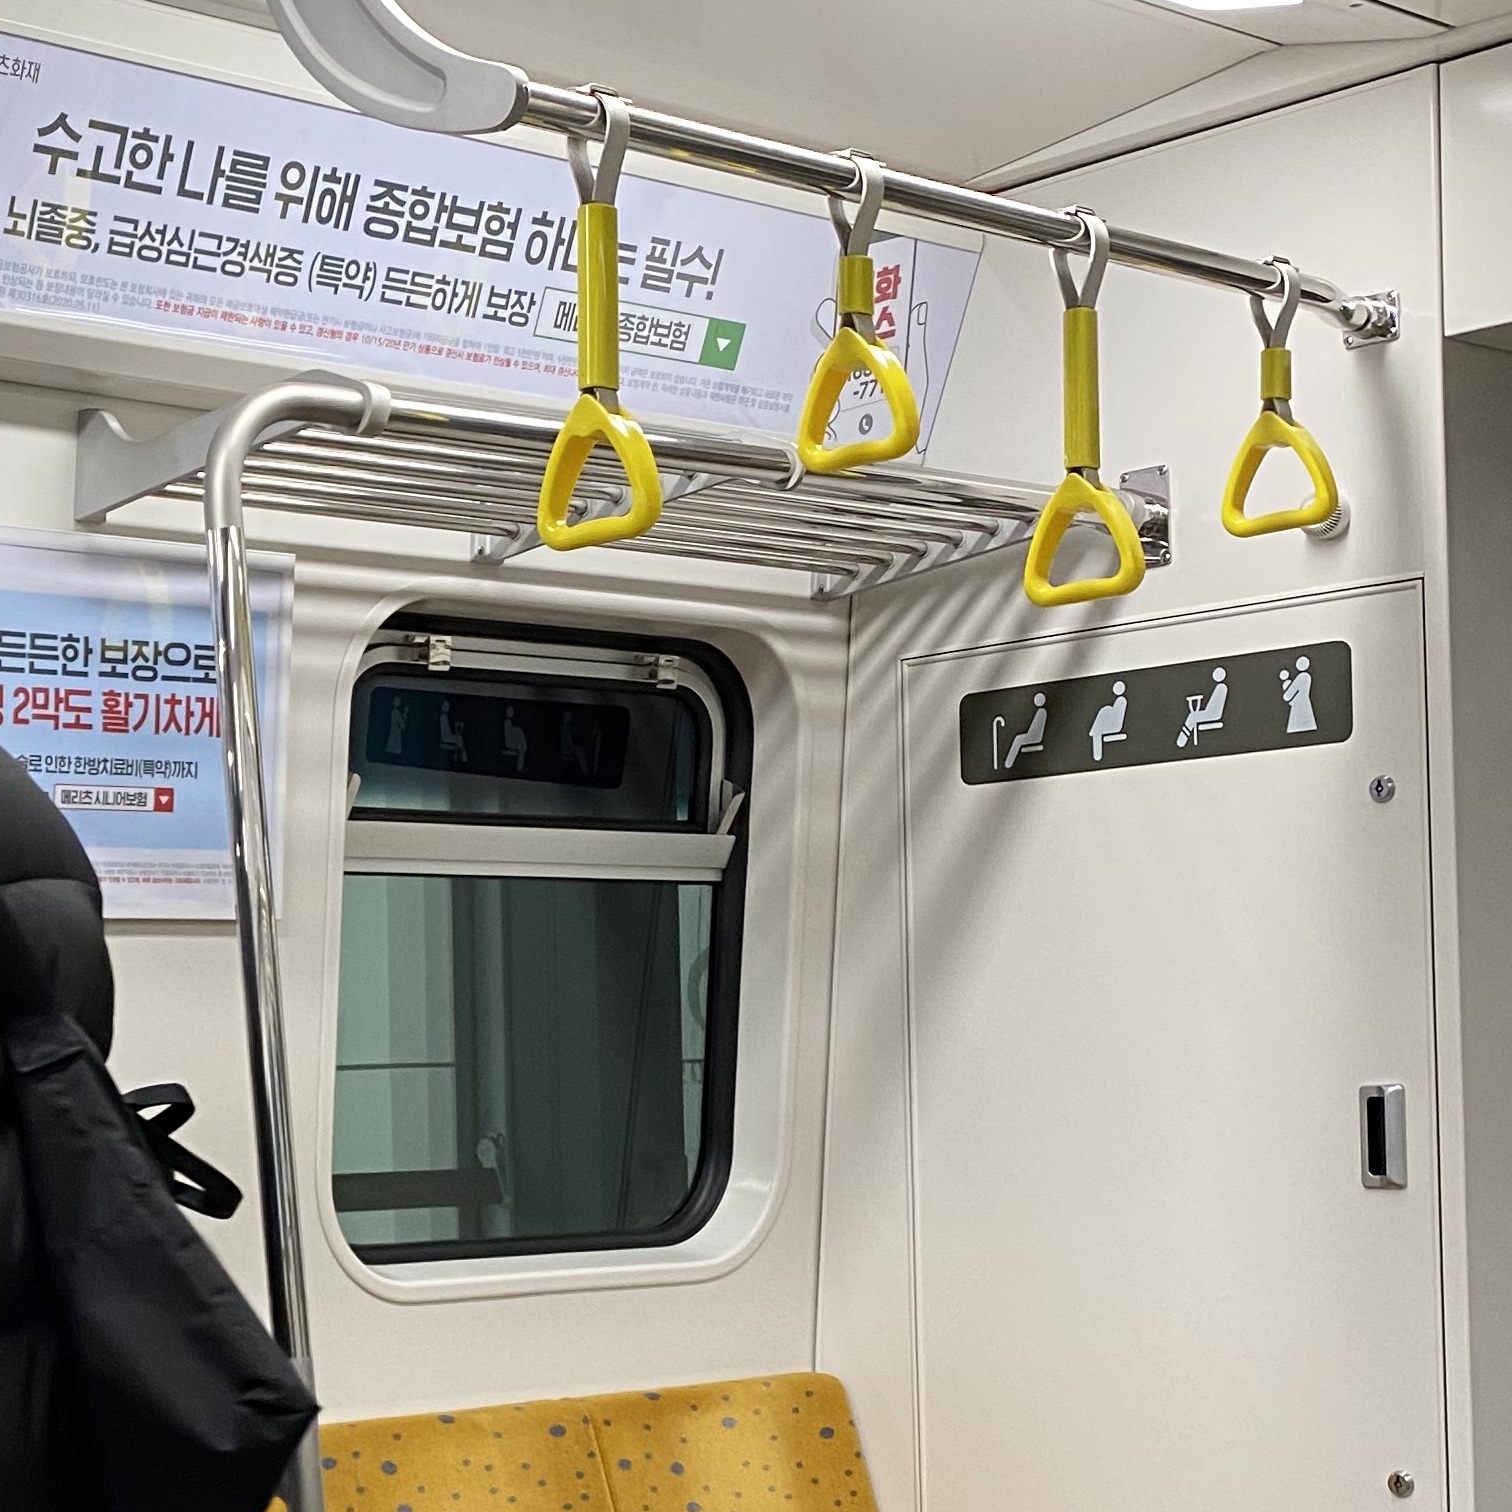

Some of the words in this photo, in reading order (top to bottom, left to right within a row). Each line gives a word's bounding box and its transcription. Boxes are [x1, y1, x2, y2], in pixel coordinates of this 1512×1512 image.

[33, 111, 175, 195] 수고한
[177, 139, 271, 214] 나를
[274, 160, 361, 232] 위해
[363, 178, 523, 262] 종합보험
[640, 236, 725, 300] 필수!
[3, 195, 99, 253] 뇌졸중,
[107, 215, 304, 288] 급성심근경색증
[308, 251, 377, 301] (특약)
[379, 266, 483, 318] 든든하게
[482, 286, 536, 328] 보장
[98, 638, 217, 684] 보장으로
[12, 686, 93, 730] 2막도
[102, 689, 221, 738] 활기차게
[45, 755, 72, 774] 인한
[74, 756, 198, 779] 한방치료비(특약)까지
[61, 789, 93, 805] 메리츠
